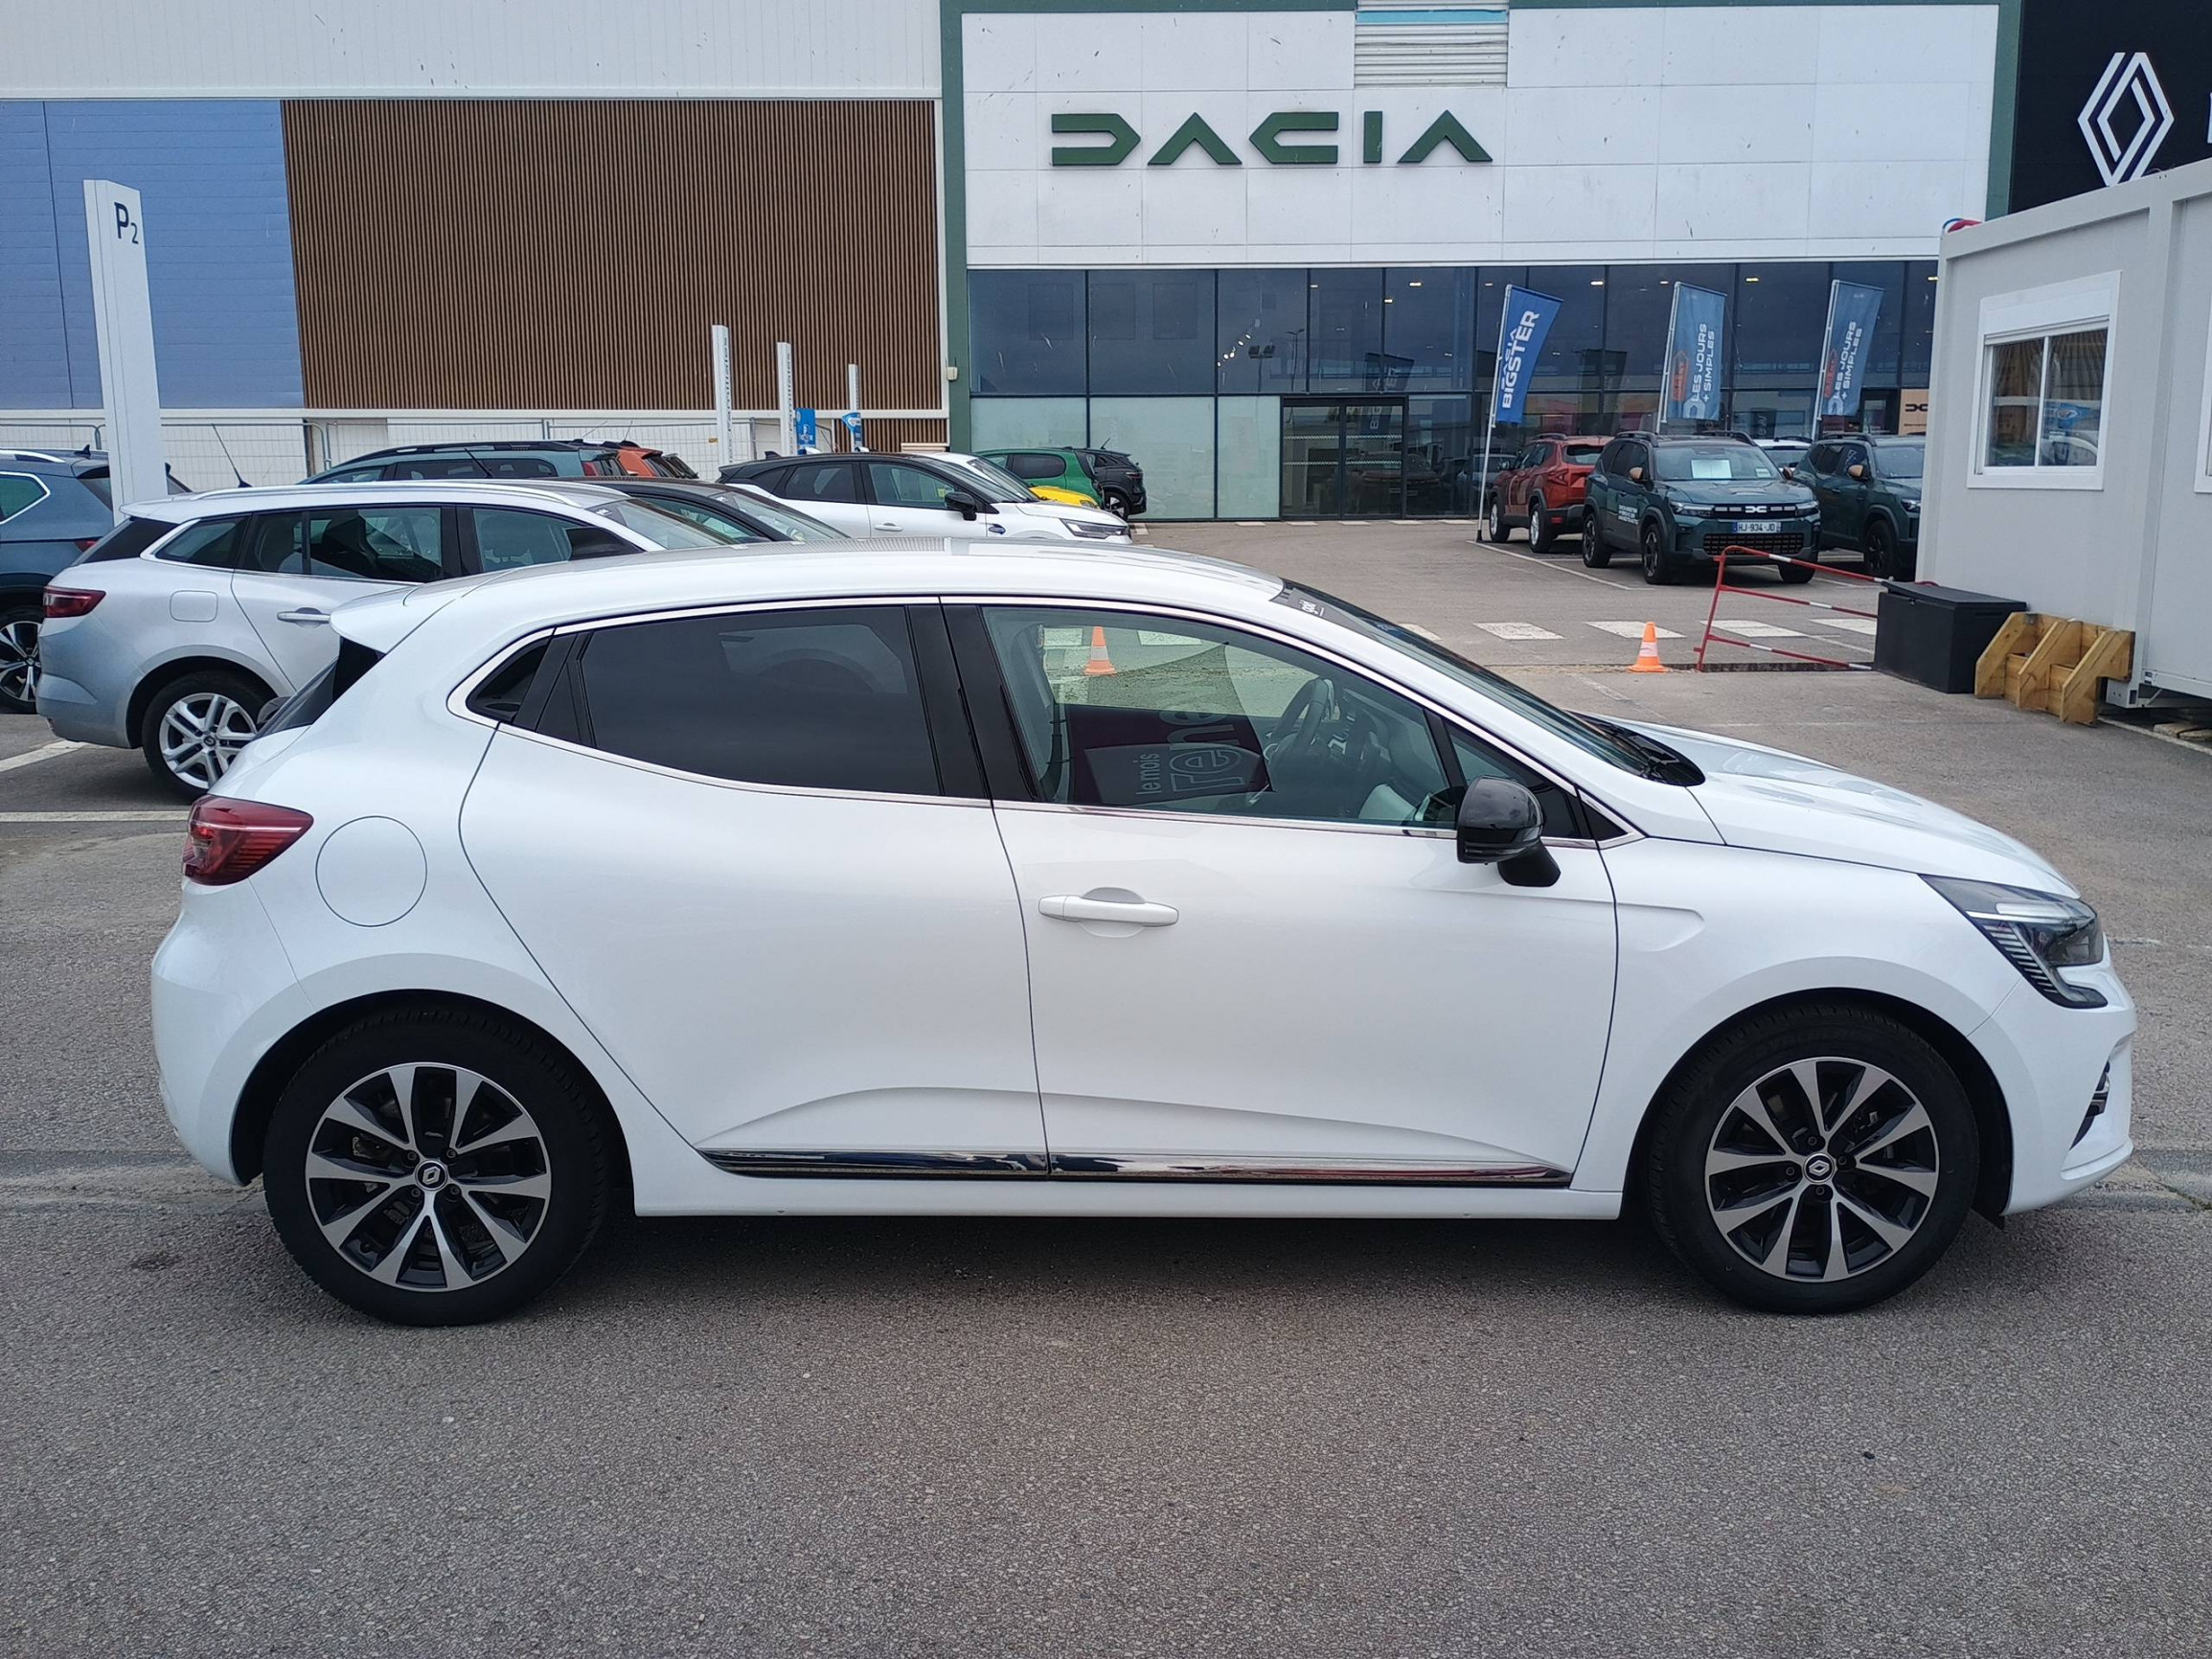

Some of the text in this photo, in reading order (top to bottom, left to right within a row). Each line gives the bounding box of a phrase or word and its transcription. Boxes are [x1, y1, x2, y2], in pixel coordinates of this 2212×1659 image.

[1051, 110, 1493, 167] DACIA
[1502, 310, 1539, 409] BIGSTER
[1691, 323, 1707, 402] LES JOURS
[1703, 330, 1715, 392] SIMPLES
[1834, 321, 1857, 399] LES JOURS
[1843, 328, 1862, 389] SIMPLES
[1132, 753, 1162, 782] mois
